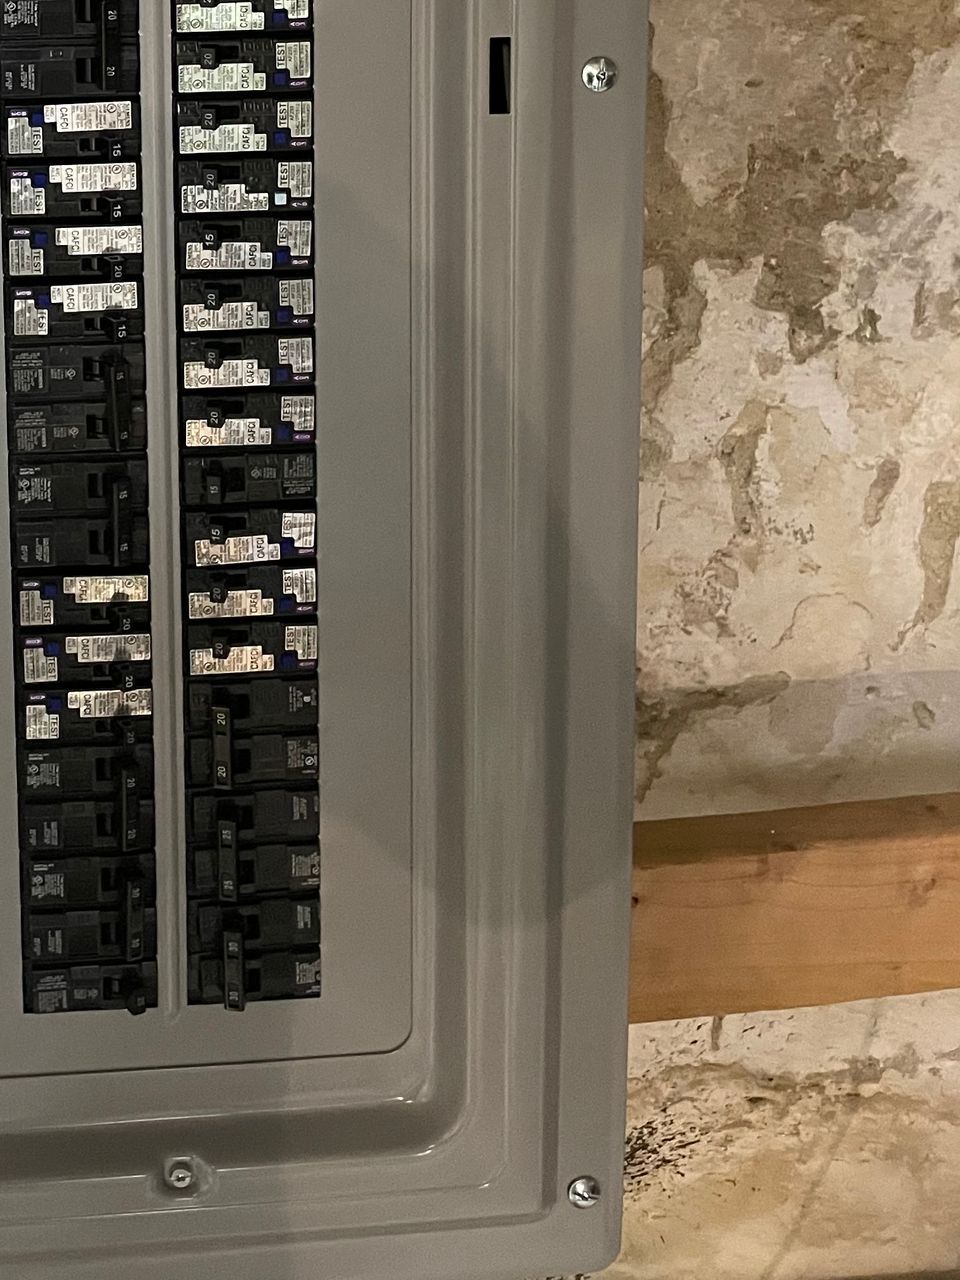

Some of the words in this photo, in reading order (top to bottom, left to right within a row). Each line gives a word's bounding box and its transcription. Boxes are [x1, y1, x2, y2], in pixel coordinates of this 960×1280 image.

[108, 10, 117, 20] 20
[240, 5, 248, 28] CAFCI
[204, 54, 212, 65] 20
[277, 45, 285, 67] TEST
[107, 67, 115, 77] 20
[242, 66, 250, 89] CAFCI
[60, 108, 68, 130] CAFCI
[205, 113, 213, 126] 20
[279, 104, 287, 126] TEST
[33, 129, 41, 152] TEST
[113, 144, 121, 157] 15
[207, 174, 214, 186] 20
[280, 164, 288, 185] TEST
[35, 190, 43, 212] TEST
[113, 205, 121, 217] 15
[279, 222, 288, 244] TEST
[206, 234, 214, 246] 15
[249, 245, 257, 267] CAFCI
[115, 266, 122, 278] 20
[67, 288, 75, 309] CAFCI
[281, 282, 289, 304] TEST
[208, 294, 216, 306] 20
[38, 312, 46, 332] TEST
[118, 326, 126, 338] 15
[208, 352, 216, 364] 20
[283, 399, 291, 419] TEST
[211, 412, 219, 424] 20
[248, 422, 256, 443] CAFCI
[212, 529, 220, 541] 15
[257, 538, 265, 559] CAFCI
[213, 588, 221, 600] 20
[42, 601, 51, 623] TEST
[123, 618, 131, 631] 20
[287, 627, 295, 649] TEST
[216, 643, 224, 655] 20
[47, 657, 56, 679] TEST
[126, 677, 133, 687] 20
[217, 713, 226, 725] 20
[50, 716, 58, 737] TEST
[128, 733, 135, 743] 20
[218, 767, 226, 777] 20
